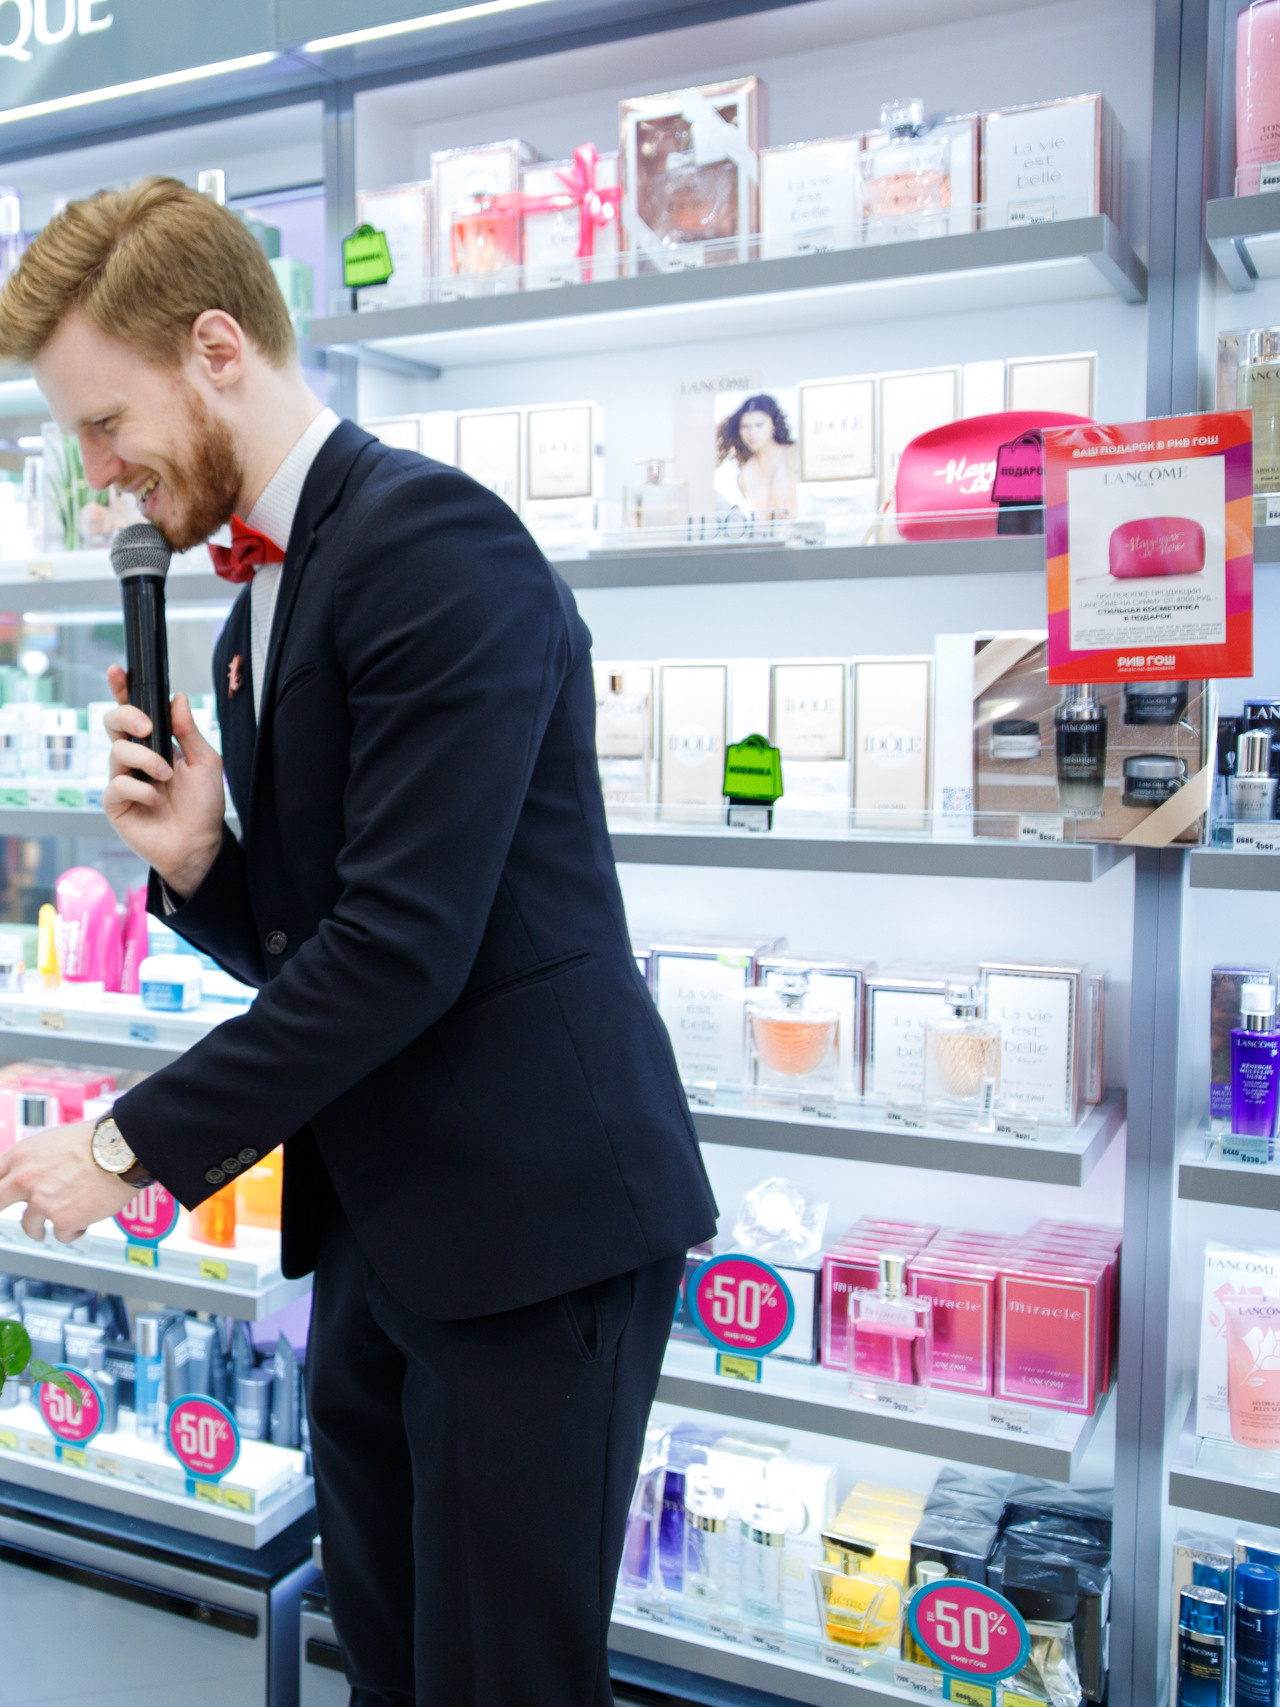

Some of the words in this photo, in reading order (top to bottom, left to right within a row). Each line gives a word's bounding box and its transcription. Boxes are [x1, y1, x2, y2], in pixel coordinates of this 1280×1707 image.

[1016, 168, 1062, 187] belle
[1072, 447, 1099, 459] ВАШ
[1100, 440, 1155, 456] ПОДАРОК
[1157, 440, 1165, 450] В
[1167, 438, 1191, 449] РИВ
[1192, 434, 1219, 446] ГОШ
[1117, 655, 1145, 667] РИВ
[1146, 654, 1176, 666] ГОШ
